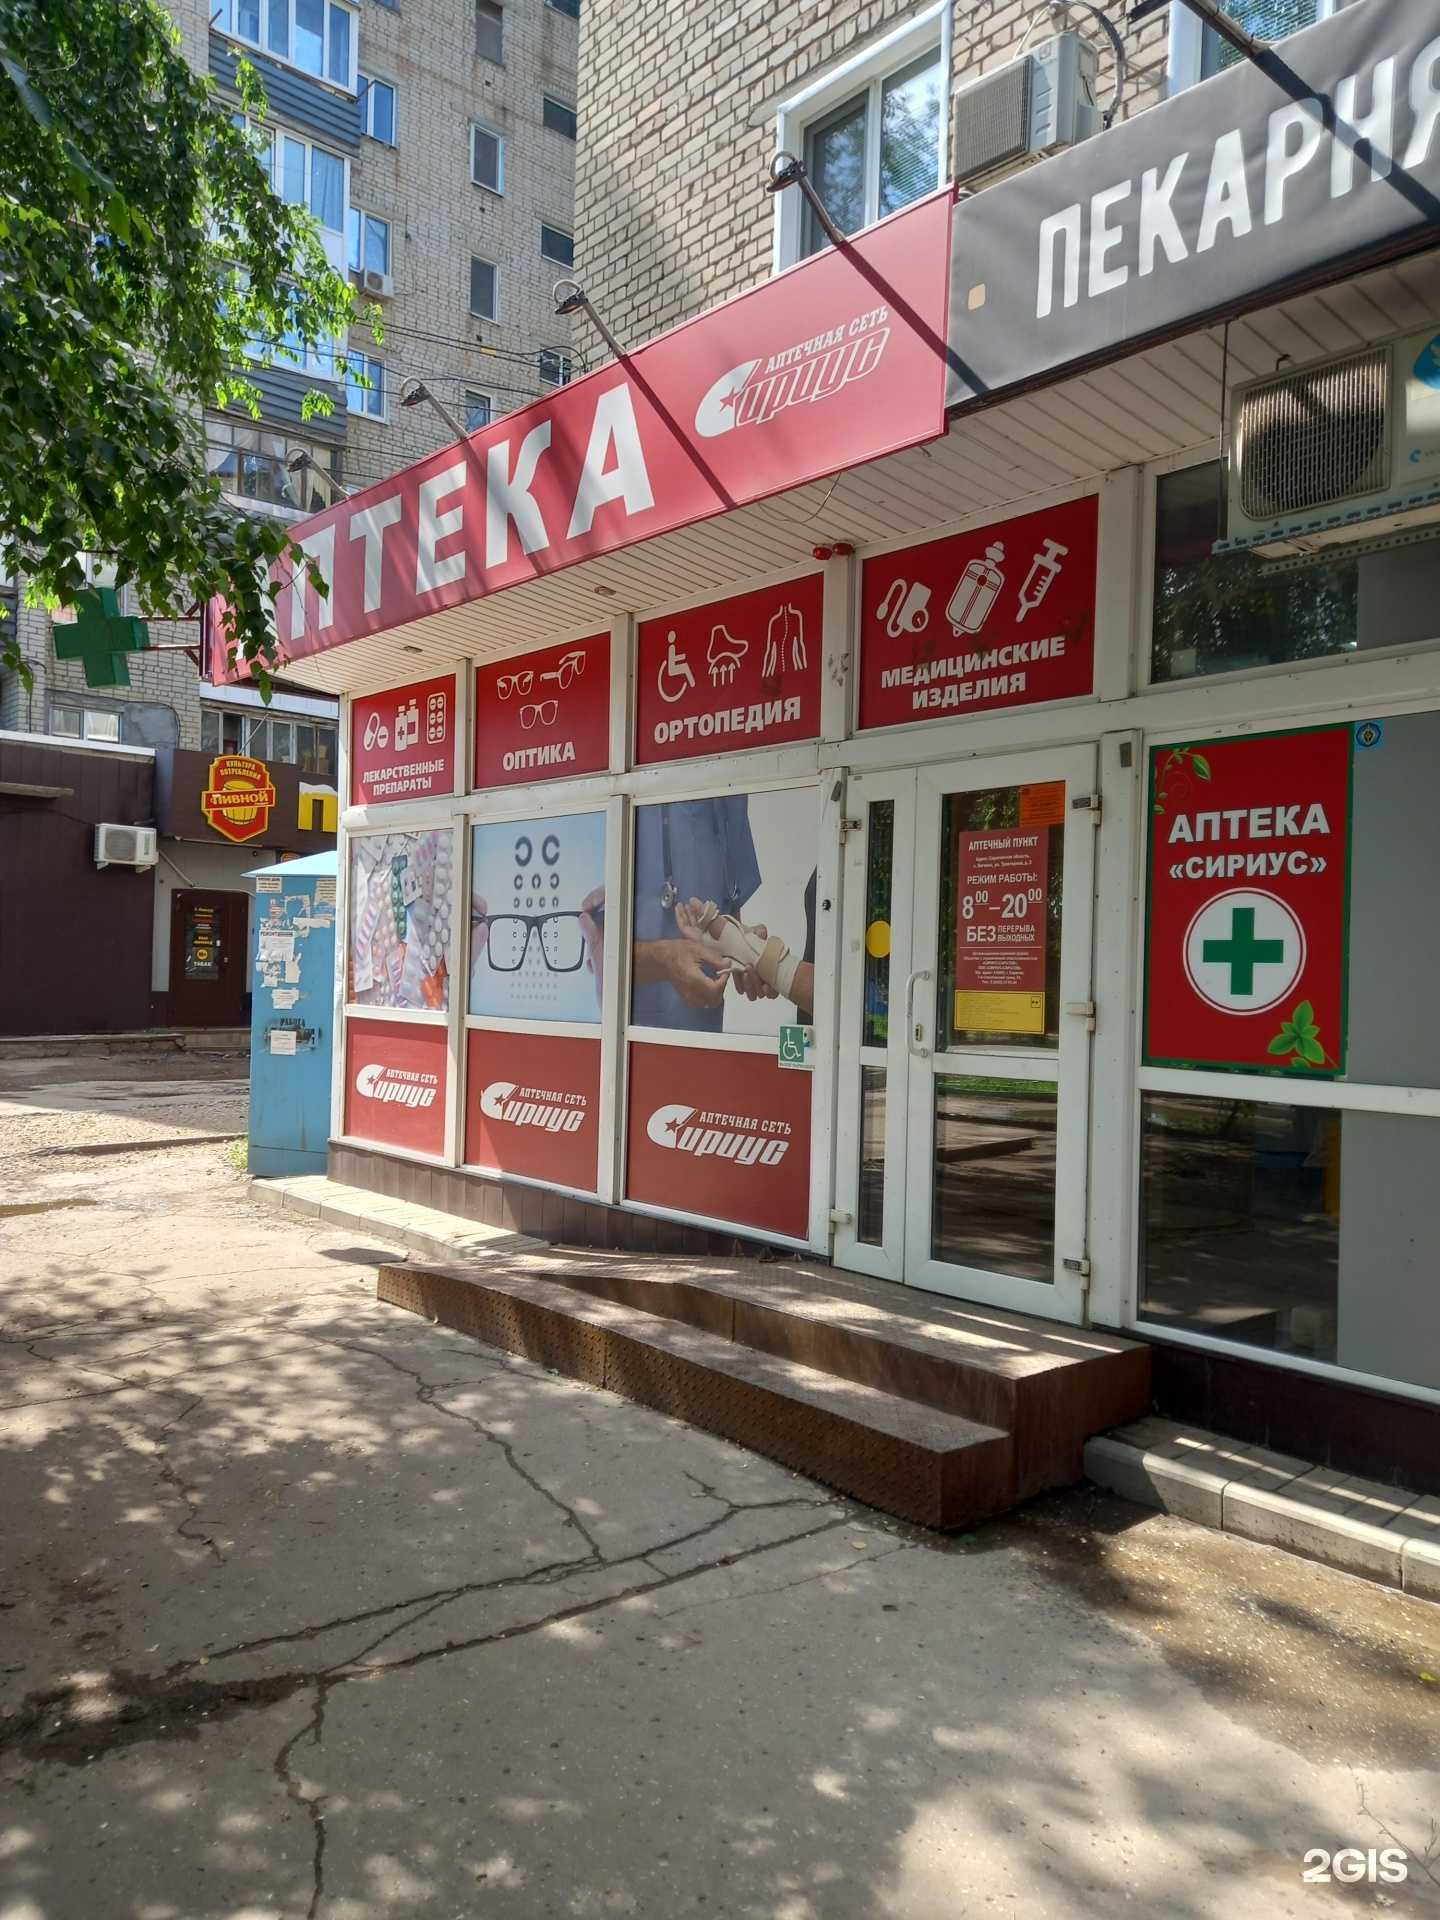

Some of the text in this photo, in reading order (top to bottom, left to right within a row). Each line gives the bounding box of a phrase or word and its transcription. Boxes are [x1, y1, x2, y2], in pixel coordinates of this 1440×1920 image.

[765, 305, 889, 375] АПТЕЧНАЯ СЕТЬ
[881, 635, 1065, 689] МЕДИЦИНСКИЕ
[912, 672, 1026, 710] ИЗДЕЛИЯ
[654, 696, 801, 744] ОРТОПЕДИЯ
[503, 742, 576, 771] ОПТИКА
[363, 759, 445, 784] ЛЕКАРСТВЕННЫЕ
[373, 776, 432, 796] ПРЕПАРАТЫ
[1168, 803, 1330, 843] АПТЕКА
[969, 836, 1039, 851] АПТЕЧНЫЙ ПУНКТ
[1169, 851, 1327, 879] «СИРИУС»
[967, 872, 1038, 885] РЕЖИМ РАБОТЫ:
[966, 925, 1035, 942] БЕЗ ПЕРЕРЫВА
[997, 934, 1035, 942] ВЫХОДНЫХ
[386, 1068, 438, 1085] АПТЕЧНАЯ СЕТЬ
[520, 1087, 587, 1106] АПТЕЧНАЯ СЕТЬ
[699, 1111, 792, 1135] АПТЕЧНАЯ СЕТЬ
